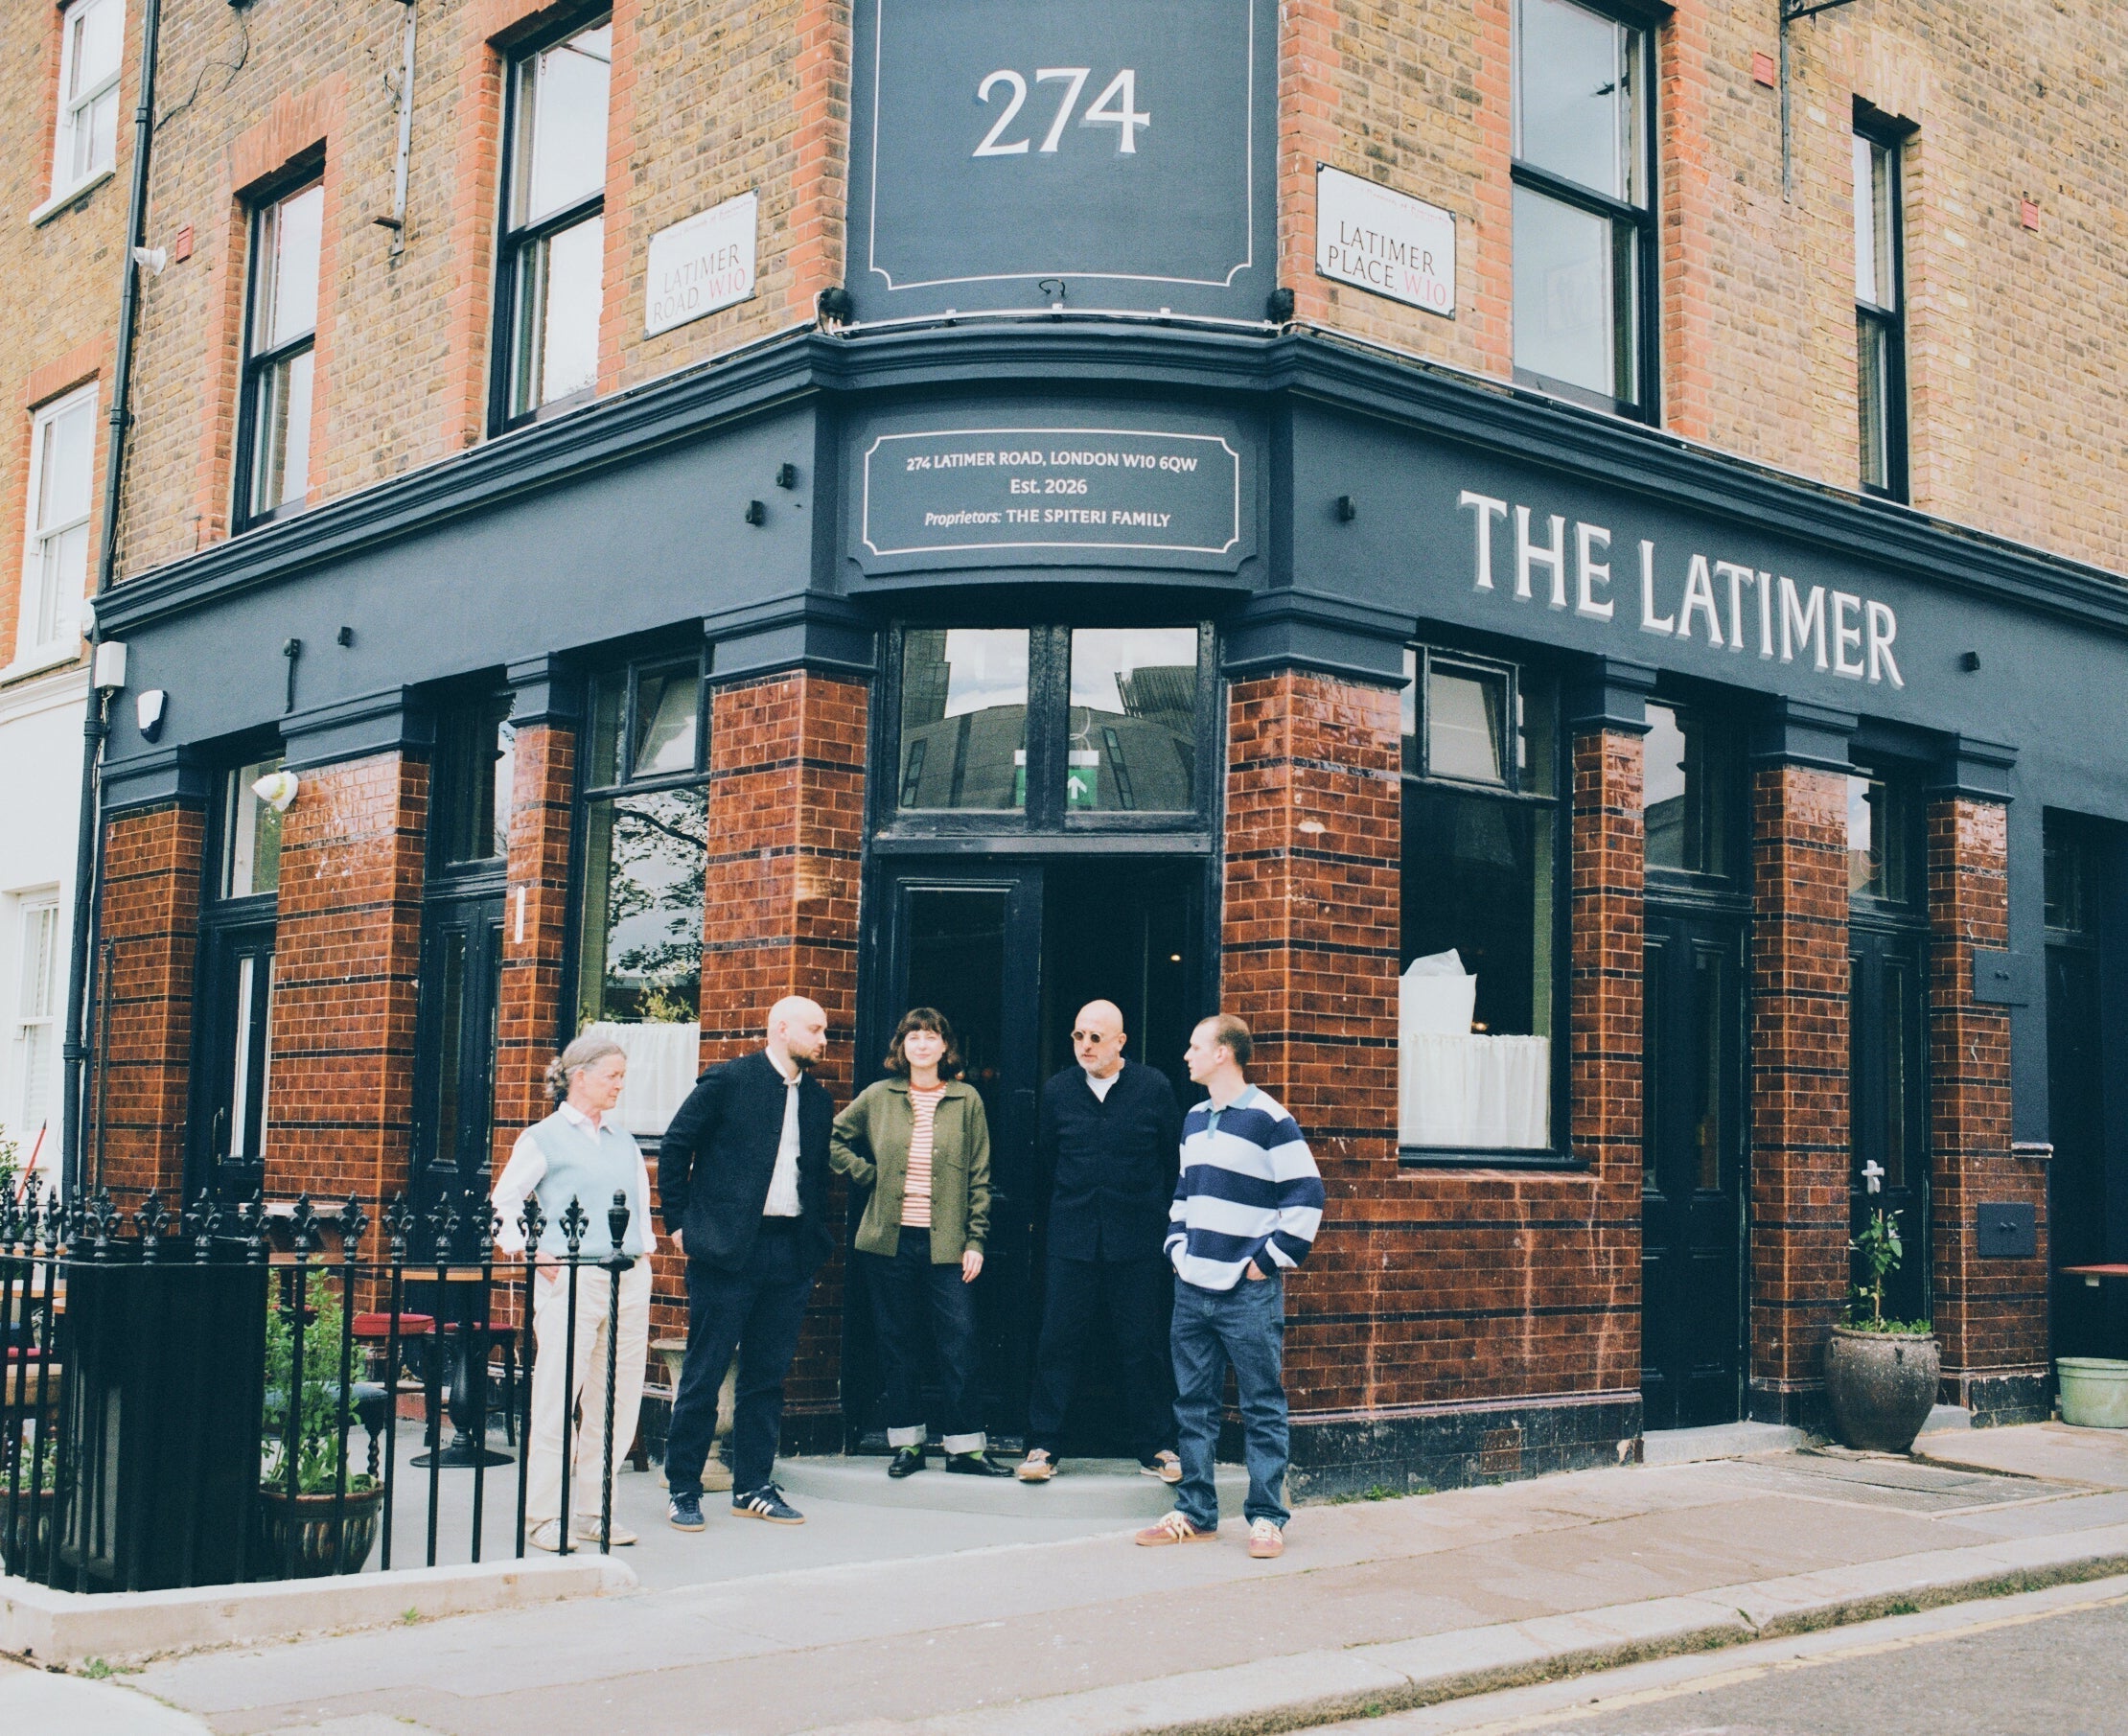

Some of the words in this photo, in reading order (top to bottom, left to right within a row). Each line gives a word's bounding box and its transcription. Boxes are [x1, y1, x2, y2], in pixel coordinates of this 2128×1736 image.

[972, 67, 1150, 157] 274
[663, 243, 740, 293] LATIMER
[1340, 220, 1436, 276] LATIMER
[907, 456, 931, 471] 274
[934, 453, 995, 469] LATIMER
[999, 451, 1047, 467] ROAD,
[1051, 451, 1119, 466] LONDON
[1122, 453, 1155, 469] W10
[1159, 456, 1197, 473] 6QW
[1010, 479, 1041, 494] Est.
[1045, 479, 1088, 494] 2026
[925, 510, 1002, 527] Proprietors:
[1006, 509, 1039, 522] THE
[1044, 509, 1106, 523] SPITERI
[1112, 511, 1170, 527] FAMILY
[1457, 489, 1615, 623] THE
[1637, 539, 1906, 690] LATIMER
